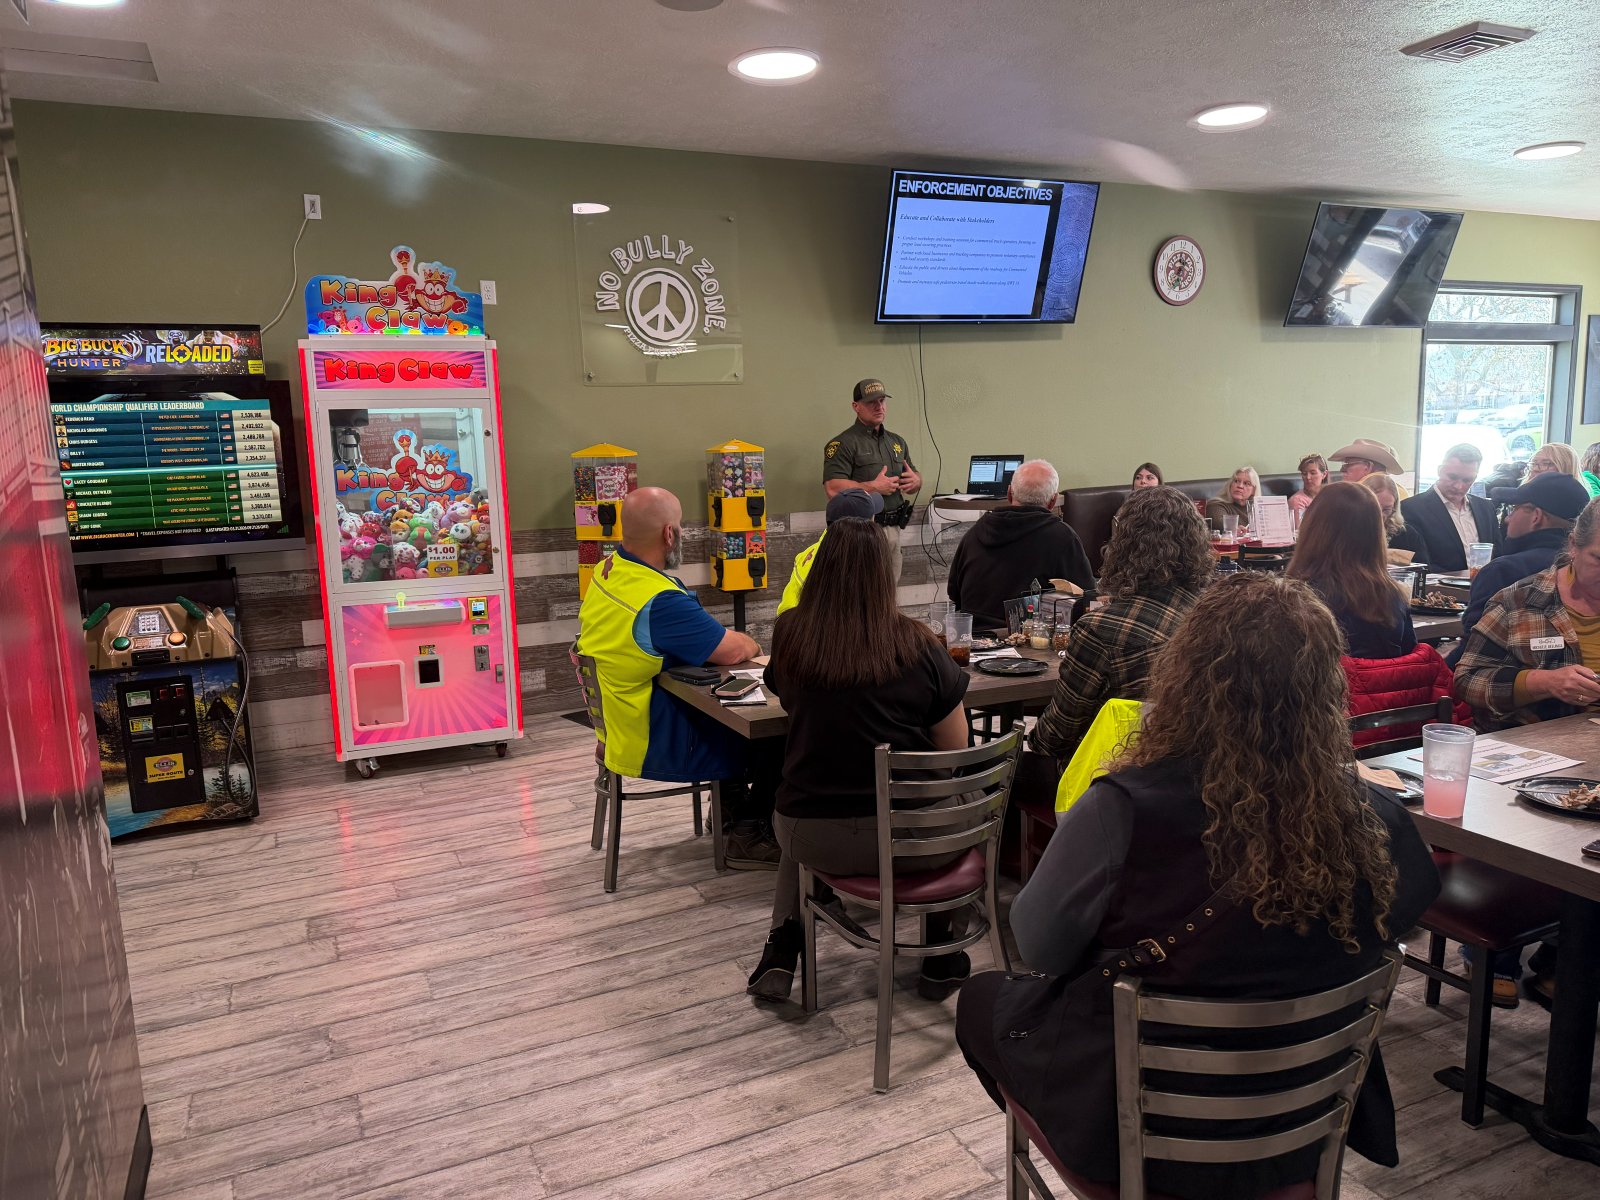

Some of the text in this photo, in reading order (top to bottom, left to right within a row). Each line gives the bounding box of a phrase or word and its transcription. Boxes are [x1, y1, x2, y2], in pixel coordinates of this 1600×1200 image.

[898, 179, 1053, 201] ENFORCEMENT OBJECTIVES
[1180, 241, 1186, 249] 12
[320, 280, 397, 307] King
[595, 234, 727, 334] NO BULLY ZONE.
[365, 306, 449, 330] Claw
[44, 338, 133, 357] BIG BUCK
[145, 343, 232, 363] RELOADED
[57, 359, 120, 367] HUNTER
[323, 357, 473, 383] King Claw
[73, 404, 123, 412] CHAMPIONSHIP
[125, 403, 158, 412] QUALIFIER
[159, 402, 204, 410] LEADERBOARD
[336, 469, 404, 492] King
